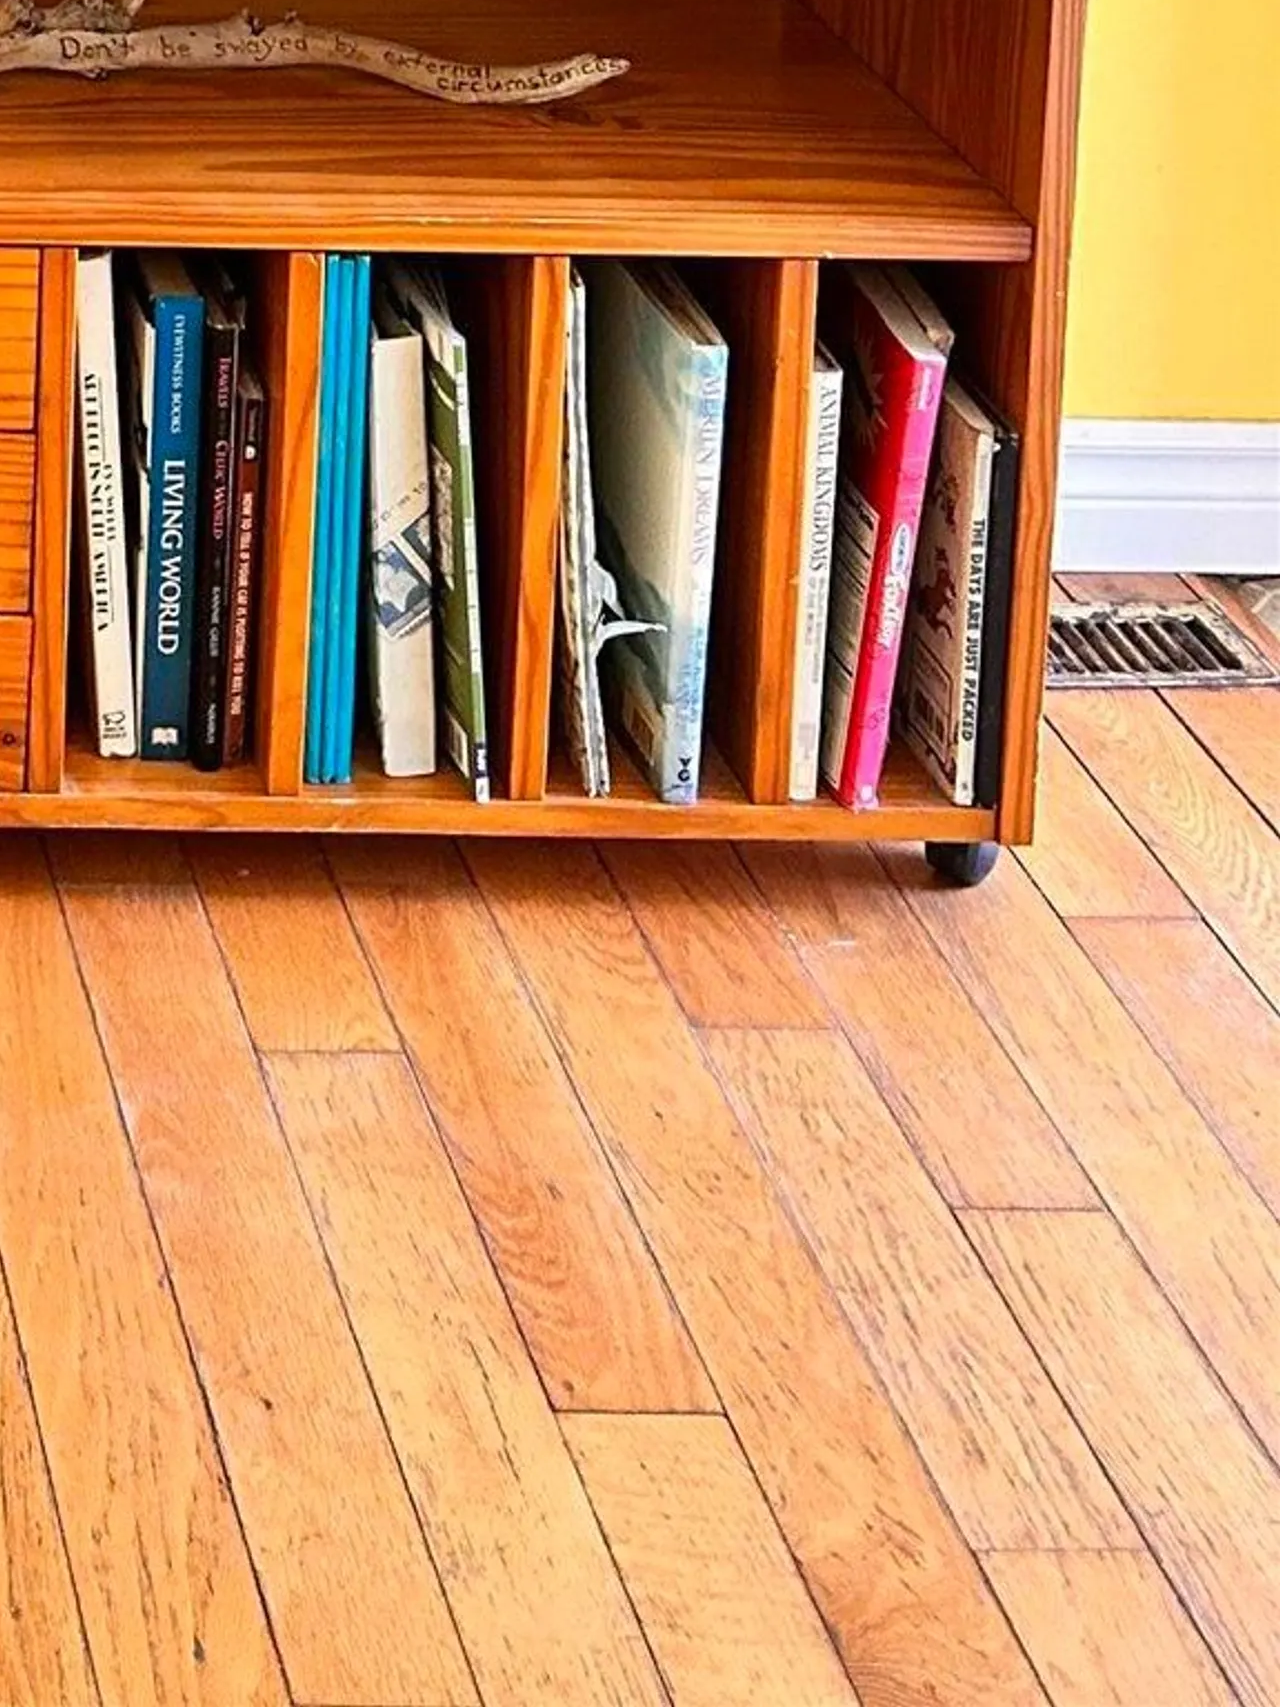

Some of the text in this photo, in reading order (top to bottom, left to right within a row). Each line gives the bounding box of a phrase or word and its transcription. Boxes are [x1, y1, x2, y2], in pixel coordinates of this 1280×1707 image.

[59, 35, 138, 60] Don't
[159, 34, 190, 59] be
[214, 34, 308, 61] swayed
[383, 50, 491, 79] external
[169, 393, 182, 434] BOOKS
[815, 385, 837, 461] ANIMAL
[158, 460, 184, 654] LIVING WORLD
[808, 466, 831, 572] KINGDOMS
[960, 519, 985, 742] THE DAYS ARE JUST PACKED
